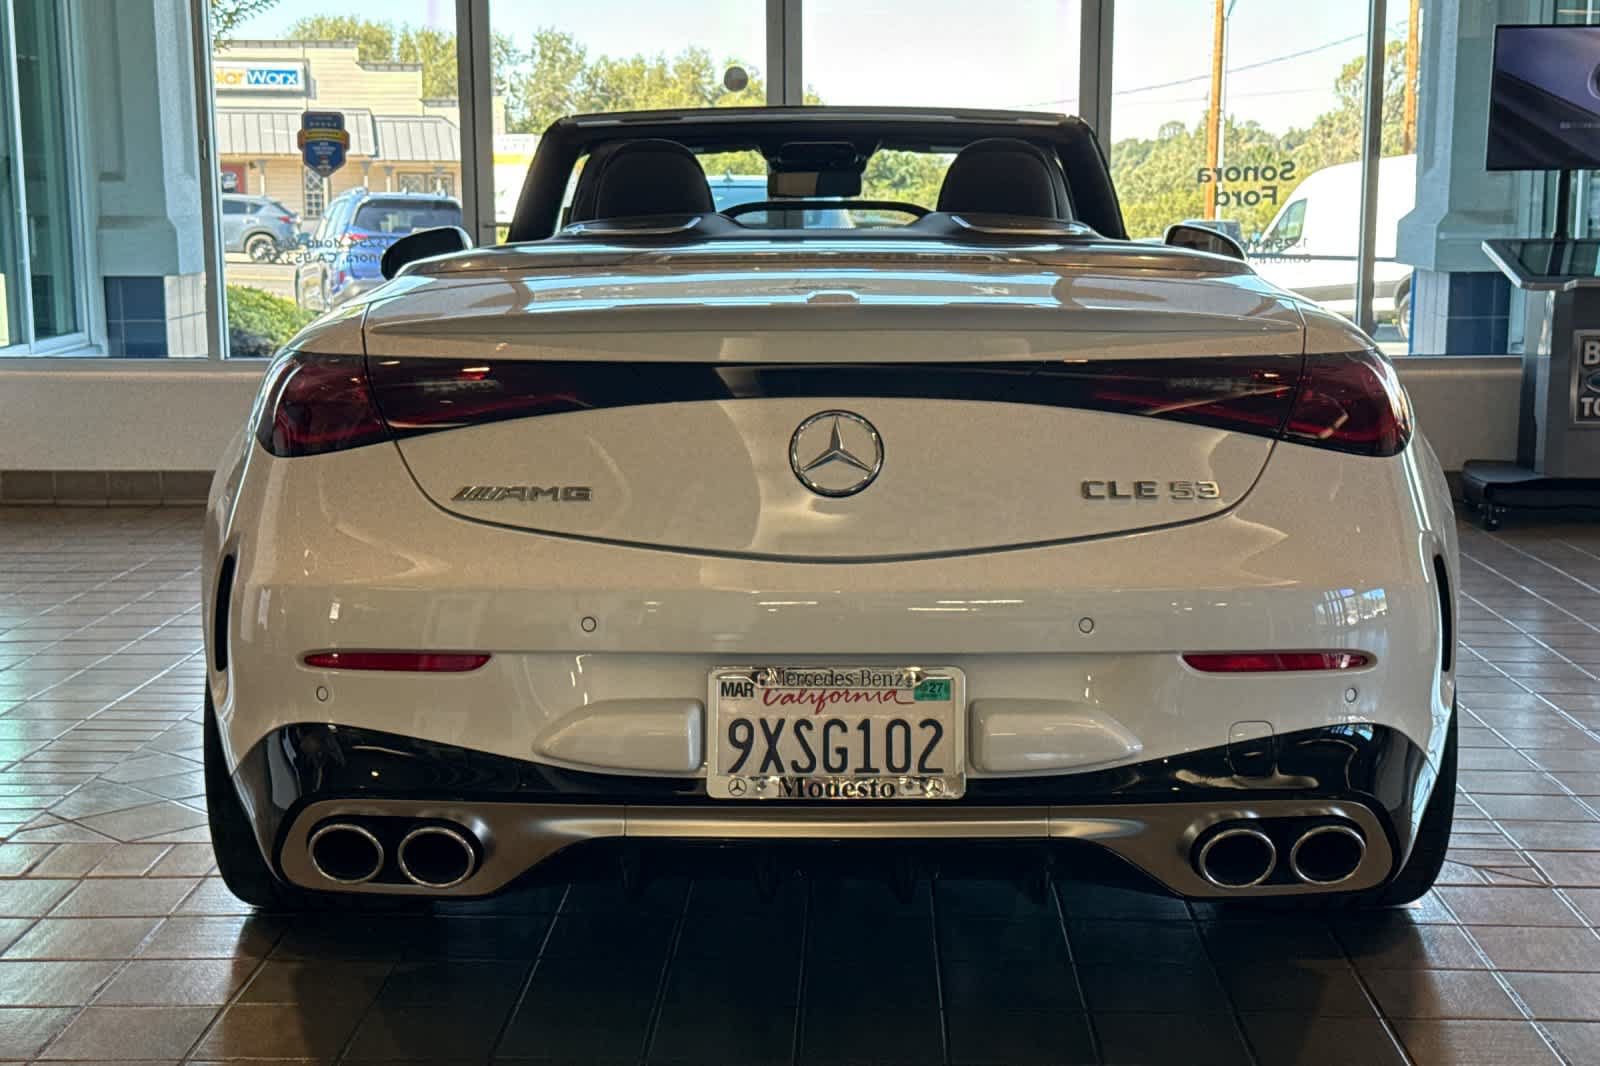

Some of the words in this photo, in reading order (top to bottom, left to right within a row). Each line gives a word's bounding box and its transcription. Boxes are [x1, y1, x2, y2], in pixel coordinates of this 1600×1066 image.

[247, 69, 297, 84] Worx
[1081, 480, 1159, 500] CLE
[1169, 480, 1220, 500] 53
[720, 681, 754, 697] MAR
[929, 682, 944, 693] 27
[762, 687, 914, 714] California
[728, 718, 944, 773] 9XSG102
[778, 776, 895, 798] Modesto
